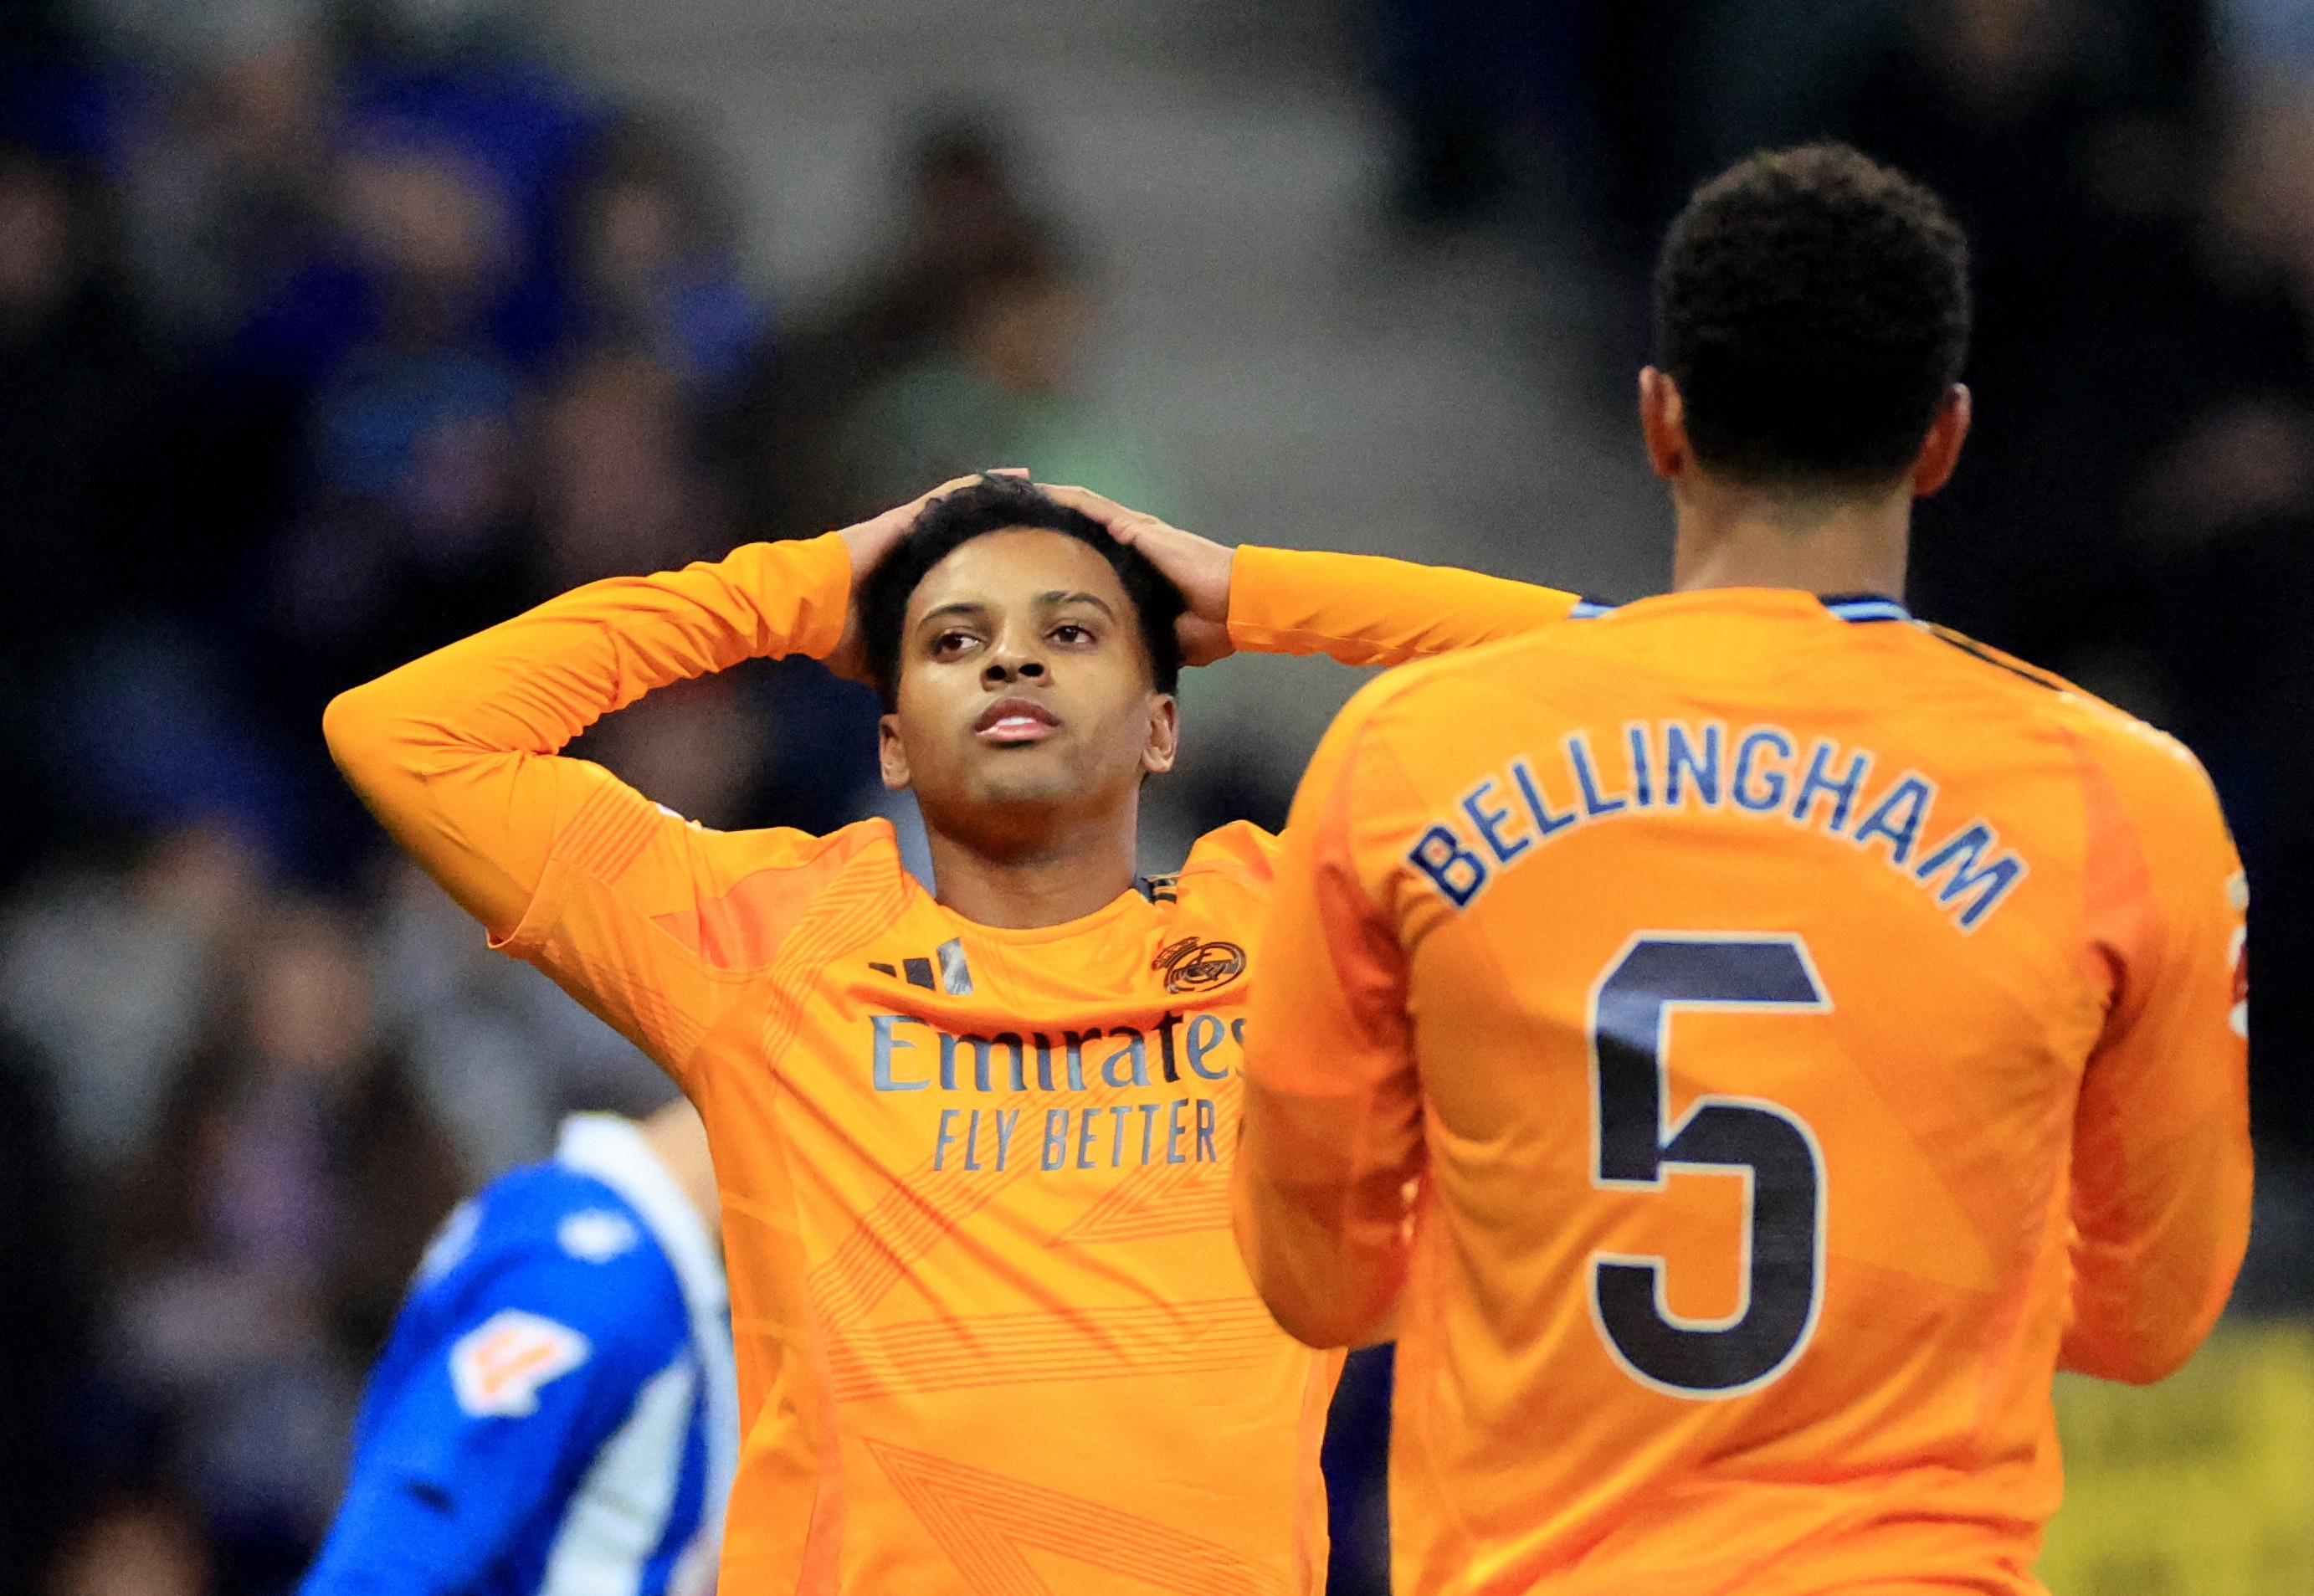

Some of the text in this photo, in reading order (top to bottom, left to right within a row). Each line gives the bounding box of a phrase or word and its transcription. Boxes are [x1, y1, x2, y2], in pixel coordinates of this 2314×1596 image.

[1408, 721, 2028, 931] BELLINGHAM
[933, 1098, 1217, 1171] FLY BETTER
[1588, 931, 1832, 1399] 5
